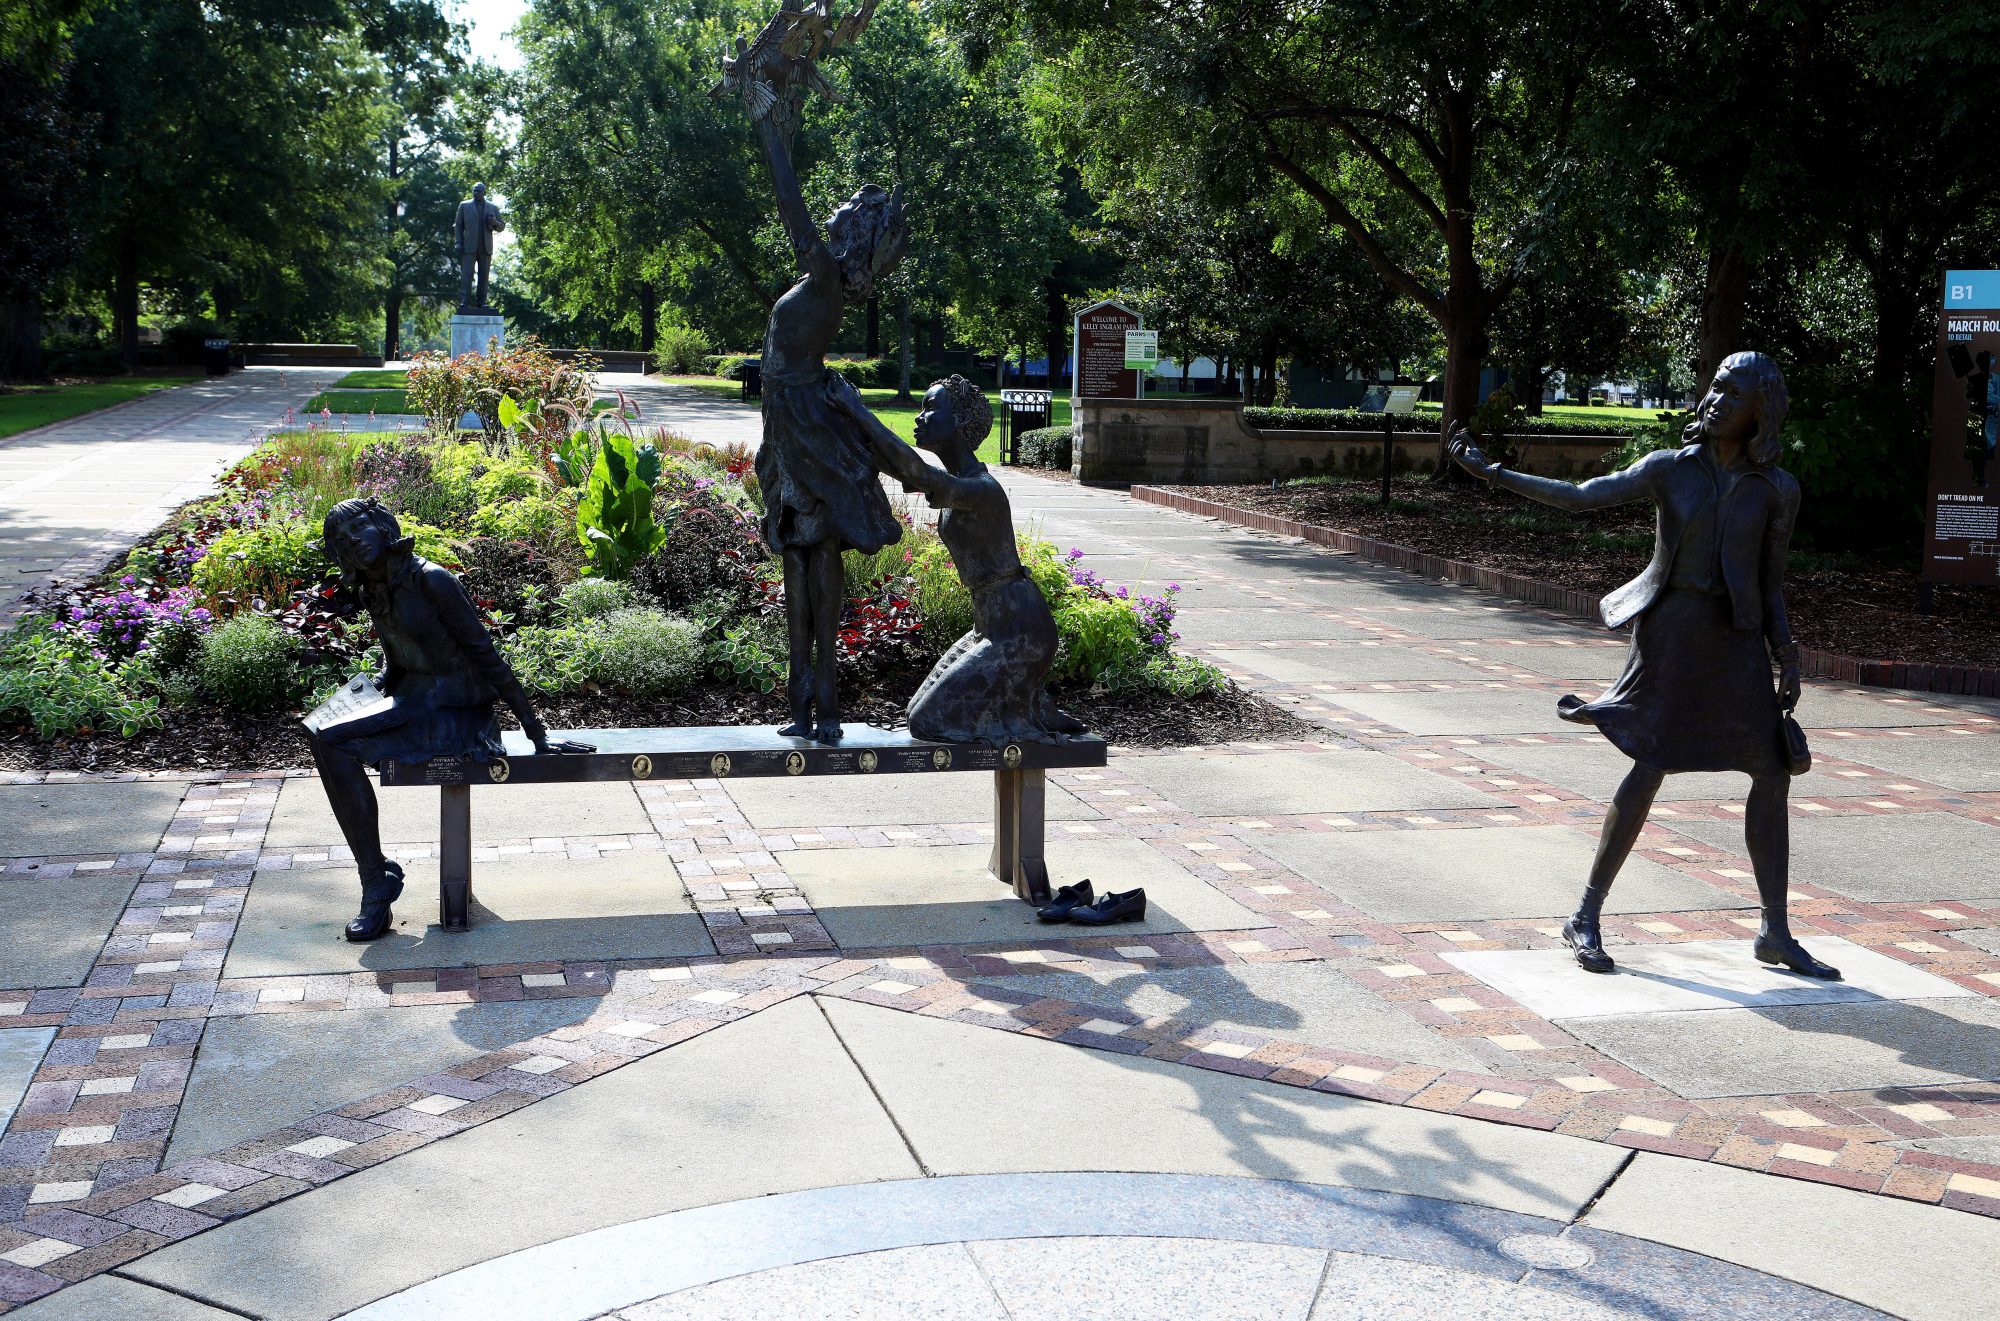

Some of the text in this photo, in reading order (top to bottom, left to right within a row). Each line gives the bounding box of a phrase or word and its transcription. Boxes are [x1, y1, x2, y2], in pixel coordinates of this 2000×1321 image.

[1951, 285, 1973, 300] B1
[1947, 320, 1981, 332] MARCH
[1947, 333, 1973, 341] TO RETAIL
[1937, 493, 1952, 501] DON'T
[1953, 494, 1968, 502] TREAD
